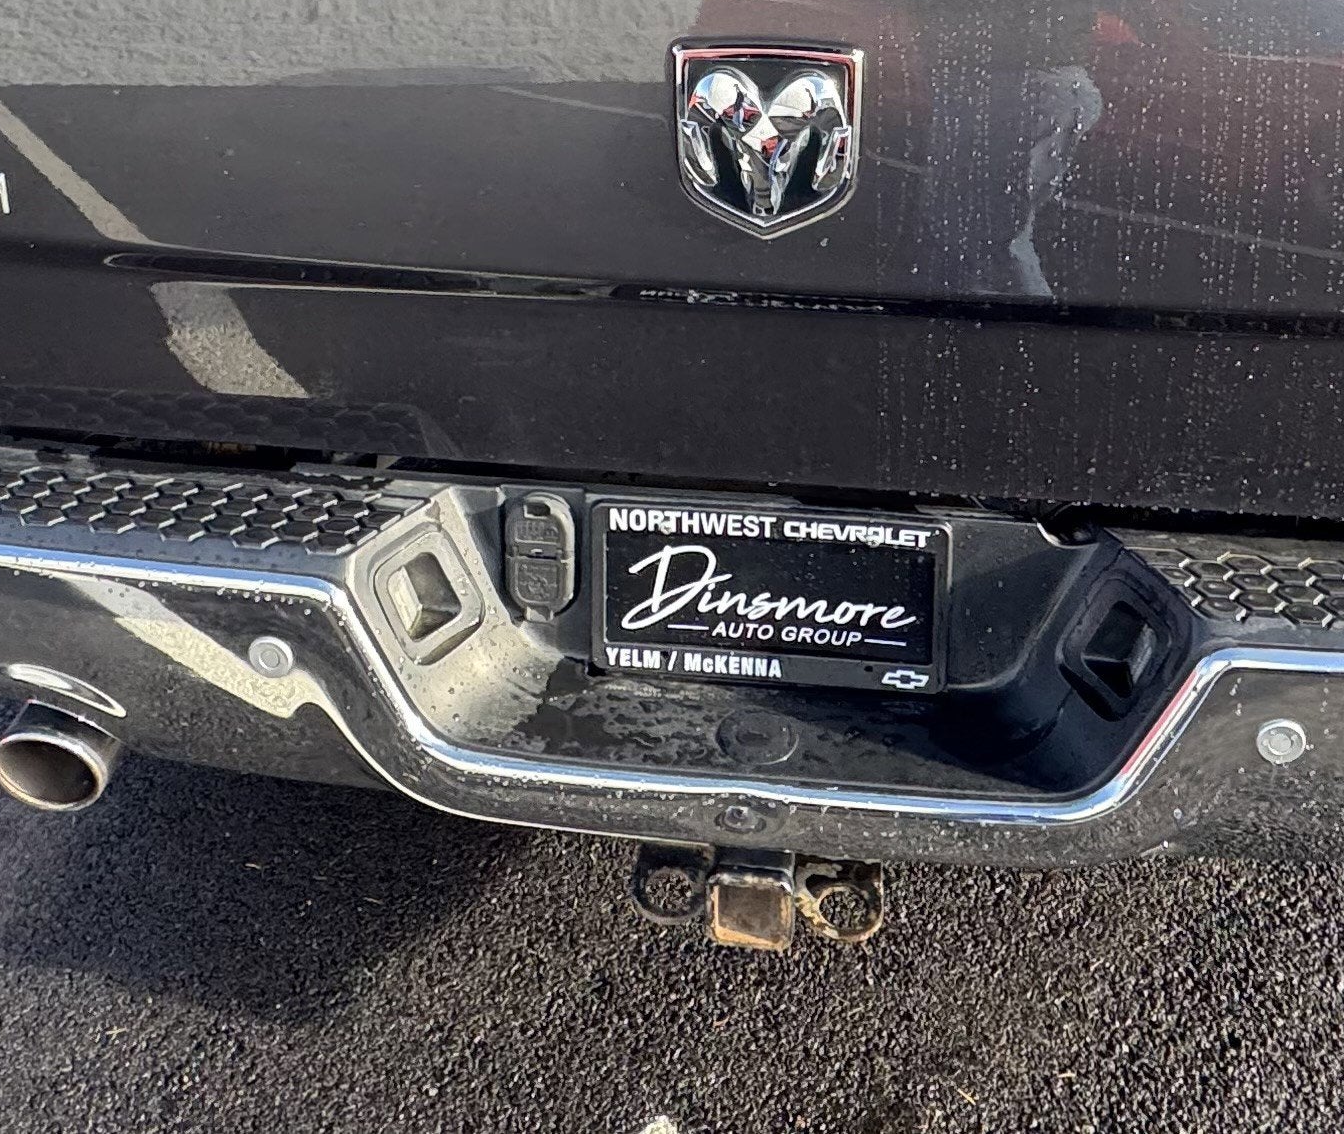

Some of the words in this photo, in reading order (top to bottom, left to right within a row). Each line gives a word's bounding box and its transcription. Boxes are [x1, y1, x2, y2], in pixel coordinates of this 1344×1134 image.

[609, 508, 777, 538] NORTHWEST
[783, 521, 931, 548] CHEVROLET
[621, 545, 916, 630] Dinsmore
[711, 621, 774, 641] AUTO
[781, 626, 863, 646] GROUP
[606, 647, 661, 669] YELM
[667, 650, 678, 671] /
[684, 652, 782, 678] McKENNA
